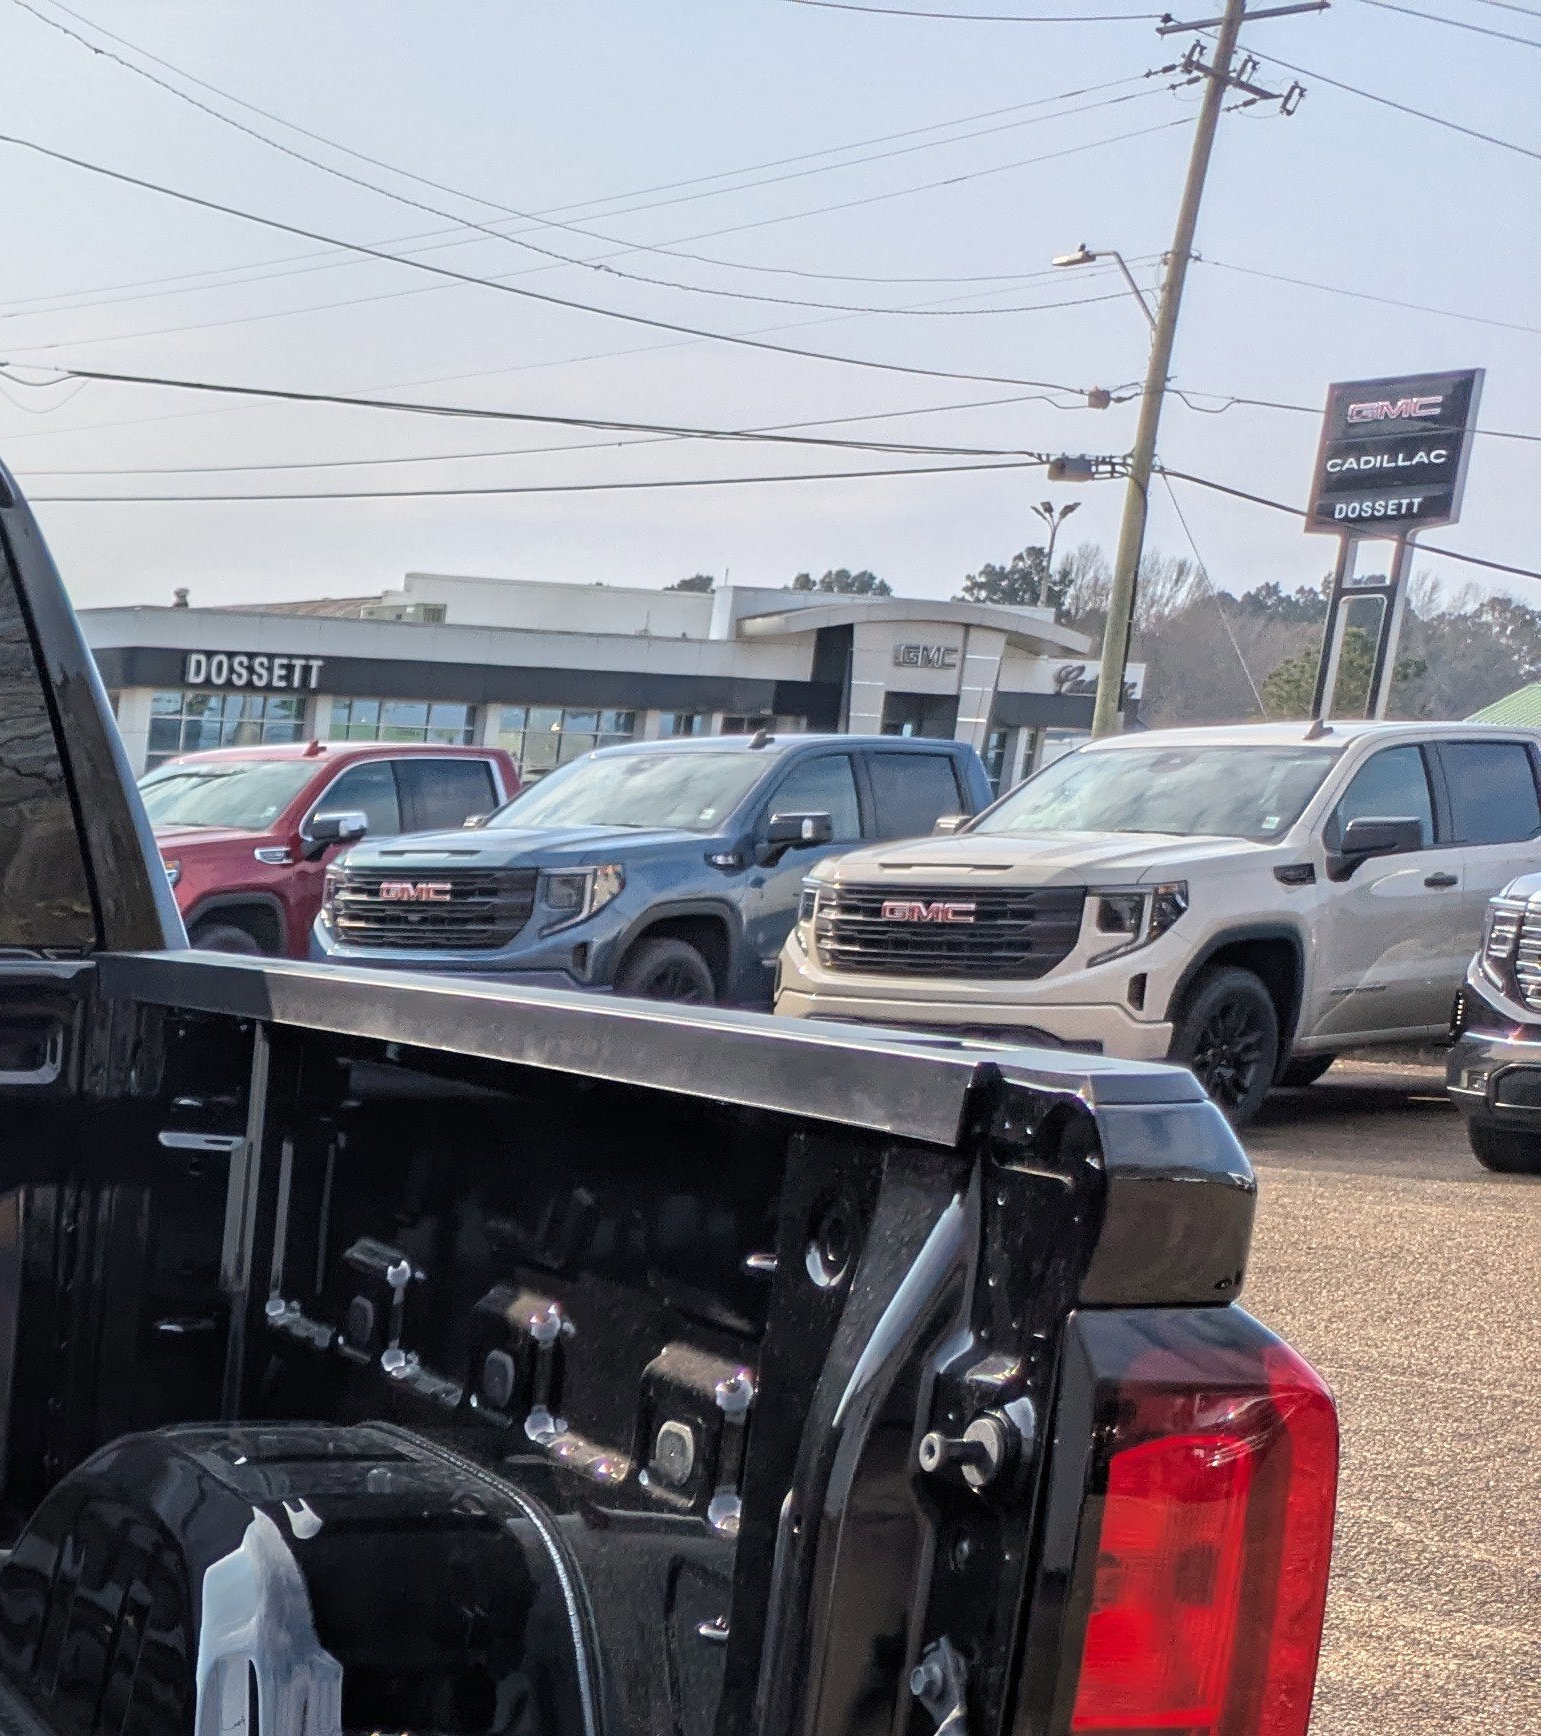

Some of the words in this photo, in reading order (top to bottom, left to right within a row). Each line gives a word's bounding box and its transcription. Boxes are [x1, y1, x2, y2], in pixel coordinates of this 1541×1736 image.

[1346, 395, 1442, 423] GMC
[1326, 449, 1447, 473] CADILLAC
[1334, 497, 1423, 519] DOSSETT
[893, 643, 959, 669] GMC
[185, 652, 324, 688] DOSSETT
[380, 882, 451, 901] GMC
[881, 901, 976, 922] GMC
